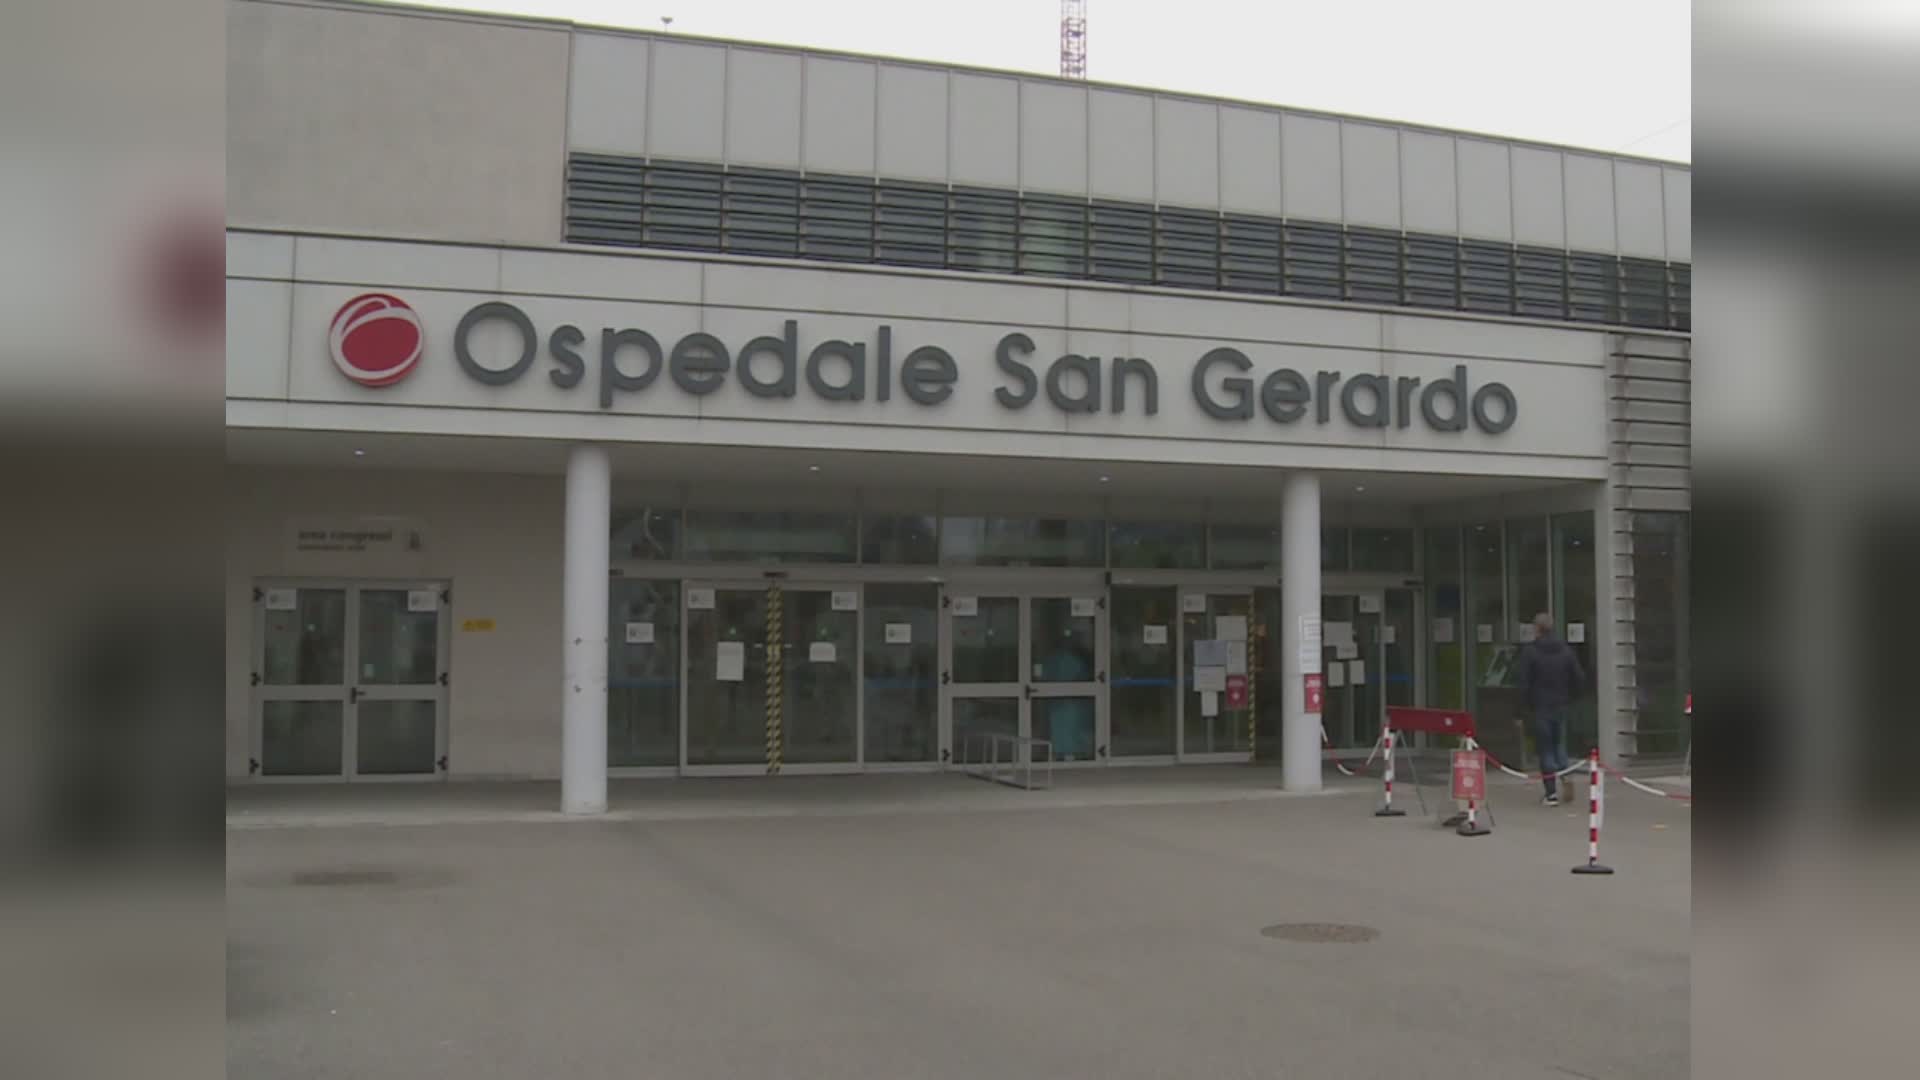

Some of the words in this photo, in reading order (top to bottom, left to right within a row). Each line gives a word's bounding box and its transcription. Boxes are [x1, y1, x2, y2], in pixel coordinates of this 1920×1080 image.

[454, 301, 958, 409] Ospedale
[994, 332, 1159, 415] San
[1191, 346, 1518, 435] Gerardo
